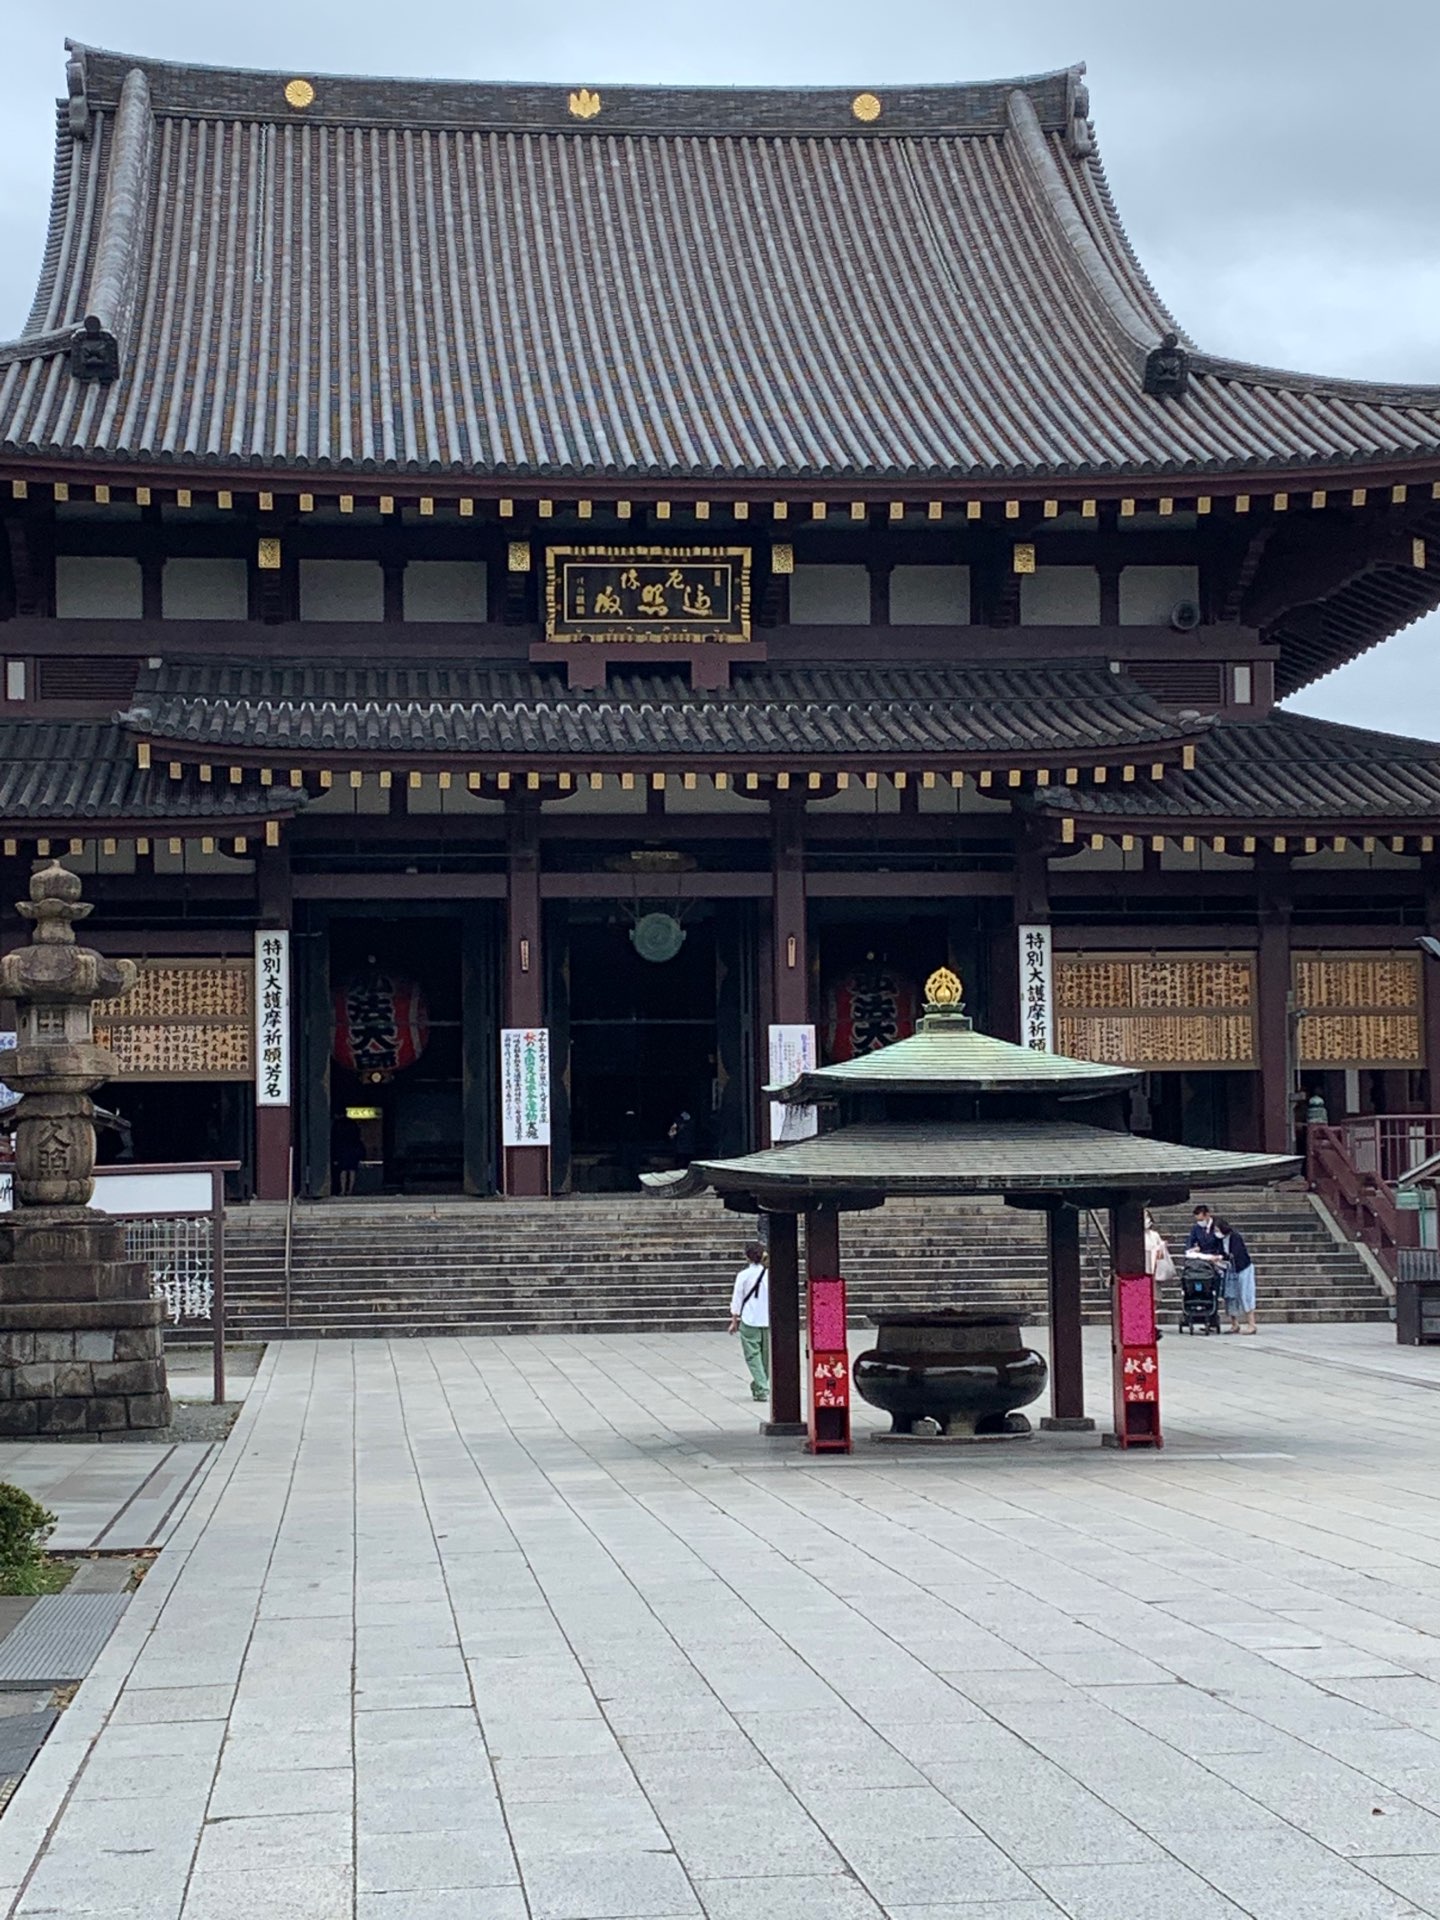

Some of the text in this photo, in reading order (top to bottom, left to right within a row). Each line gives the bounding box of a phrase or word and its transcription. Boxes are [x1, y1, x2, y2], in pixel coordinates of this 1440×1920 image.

[262, 938, 283, 1098] 特別大護摩祈願芳名
